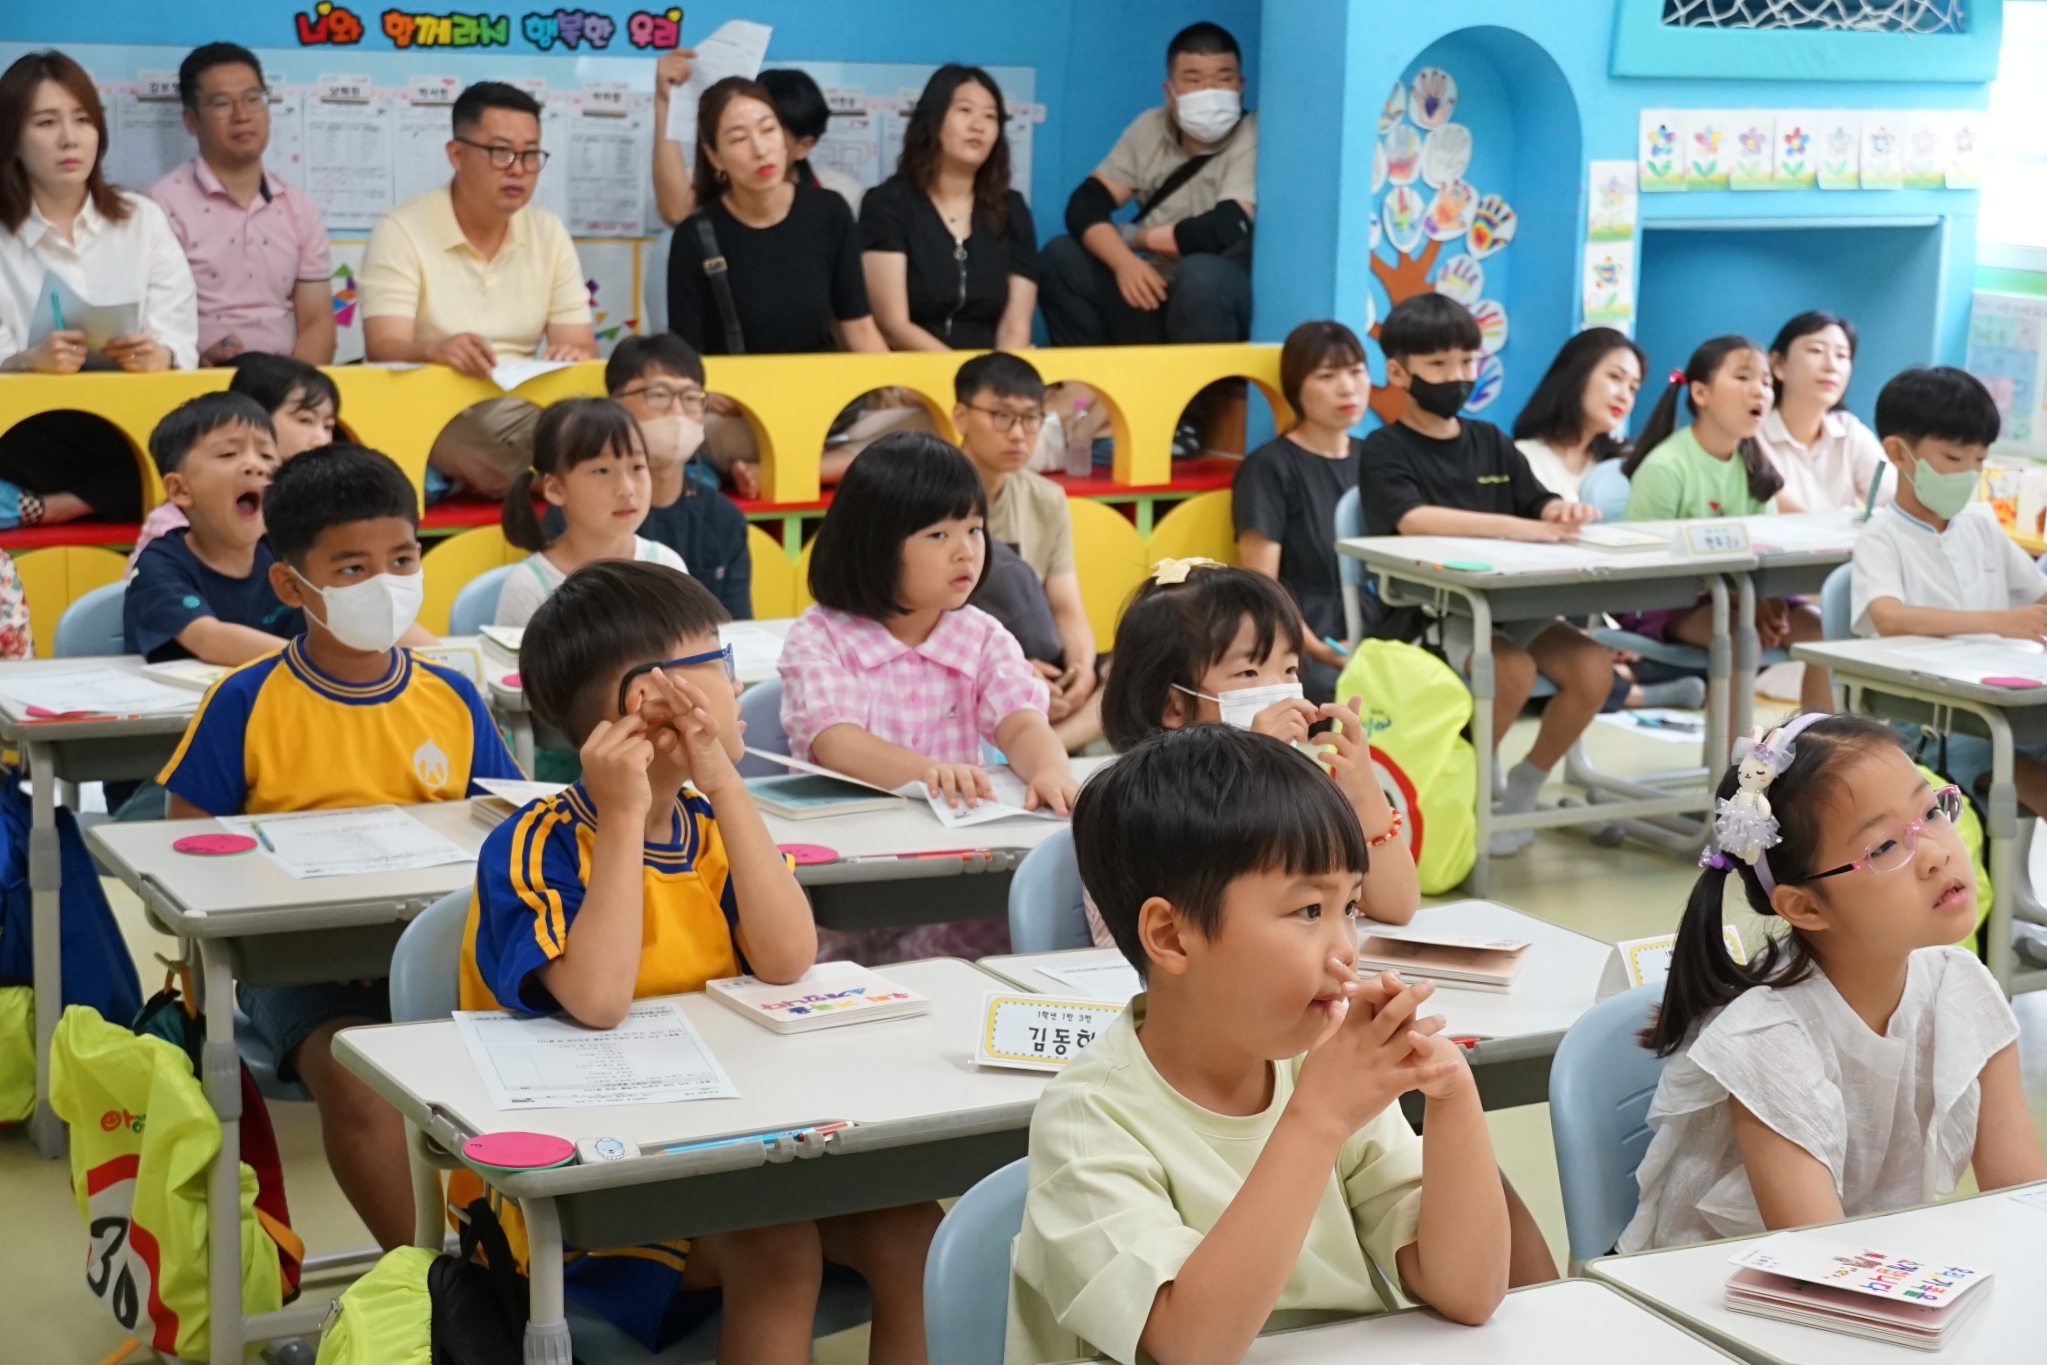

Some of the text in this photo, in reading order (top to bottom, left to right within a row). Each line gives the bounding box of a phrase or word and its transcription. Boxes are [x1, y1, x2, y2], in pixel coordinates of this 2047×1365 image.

[294, 2, 683, 50] 너와 함께라서 행복한 우리
[1037, 1010, 1092, 1024] 1학년 1반 3번
[1858, 1259, 1925, 1293] 소개합니다
[1903, 1278, 1954, 1301] 가족을
